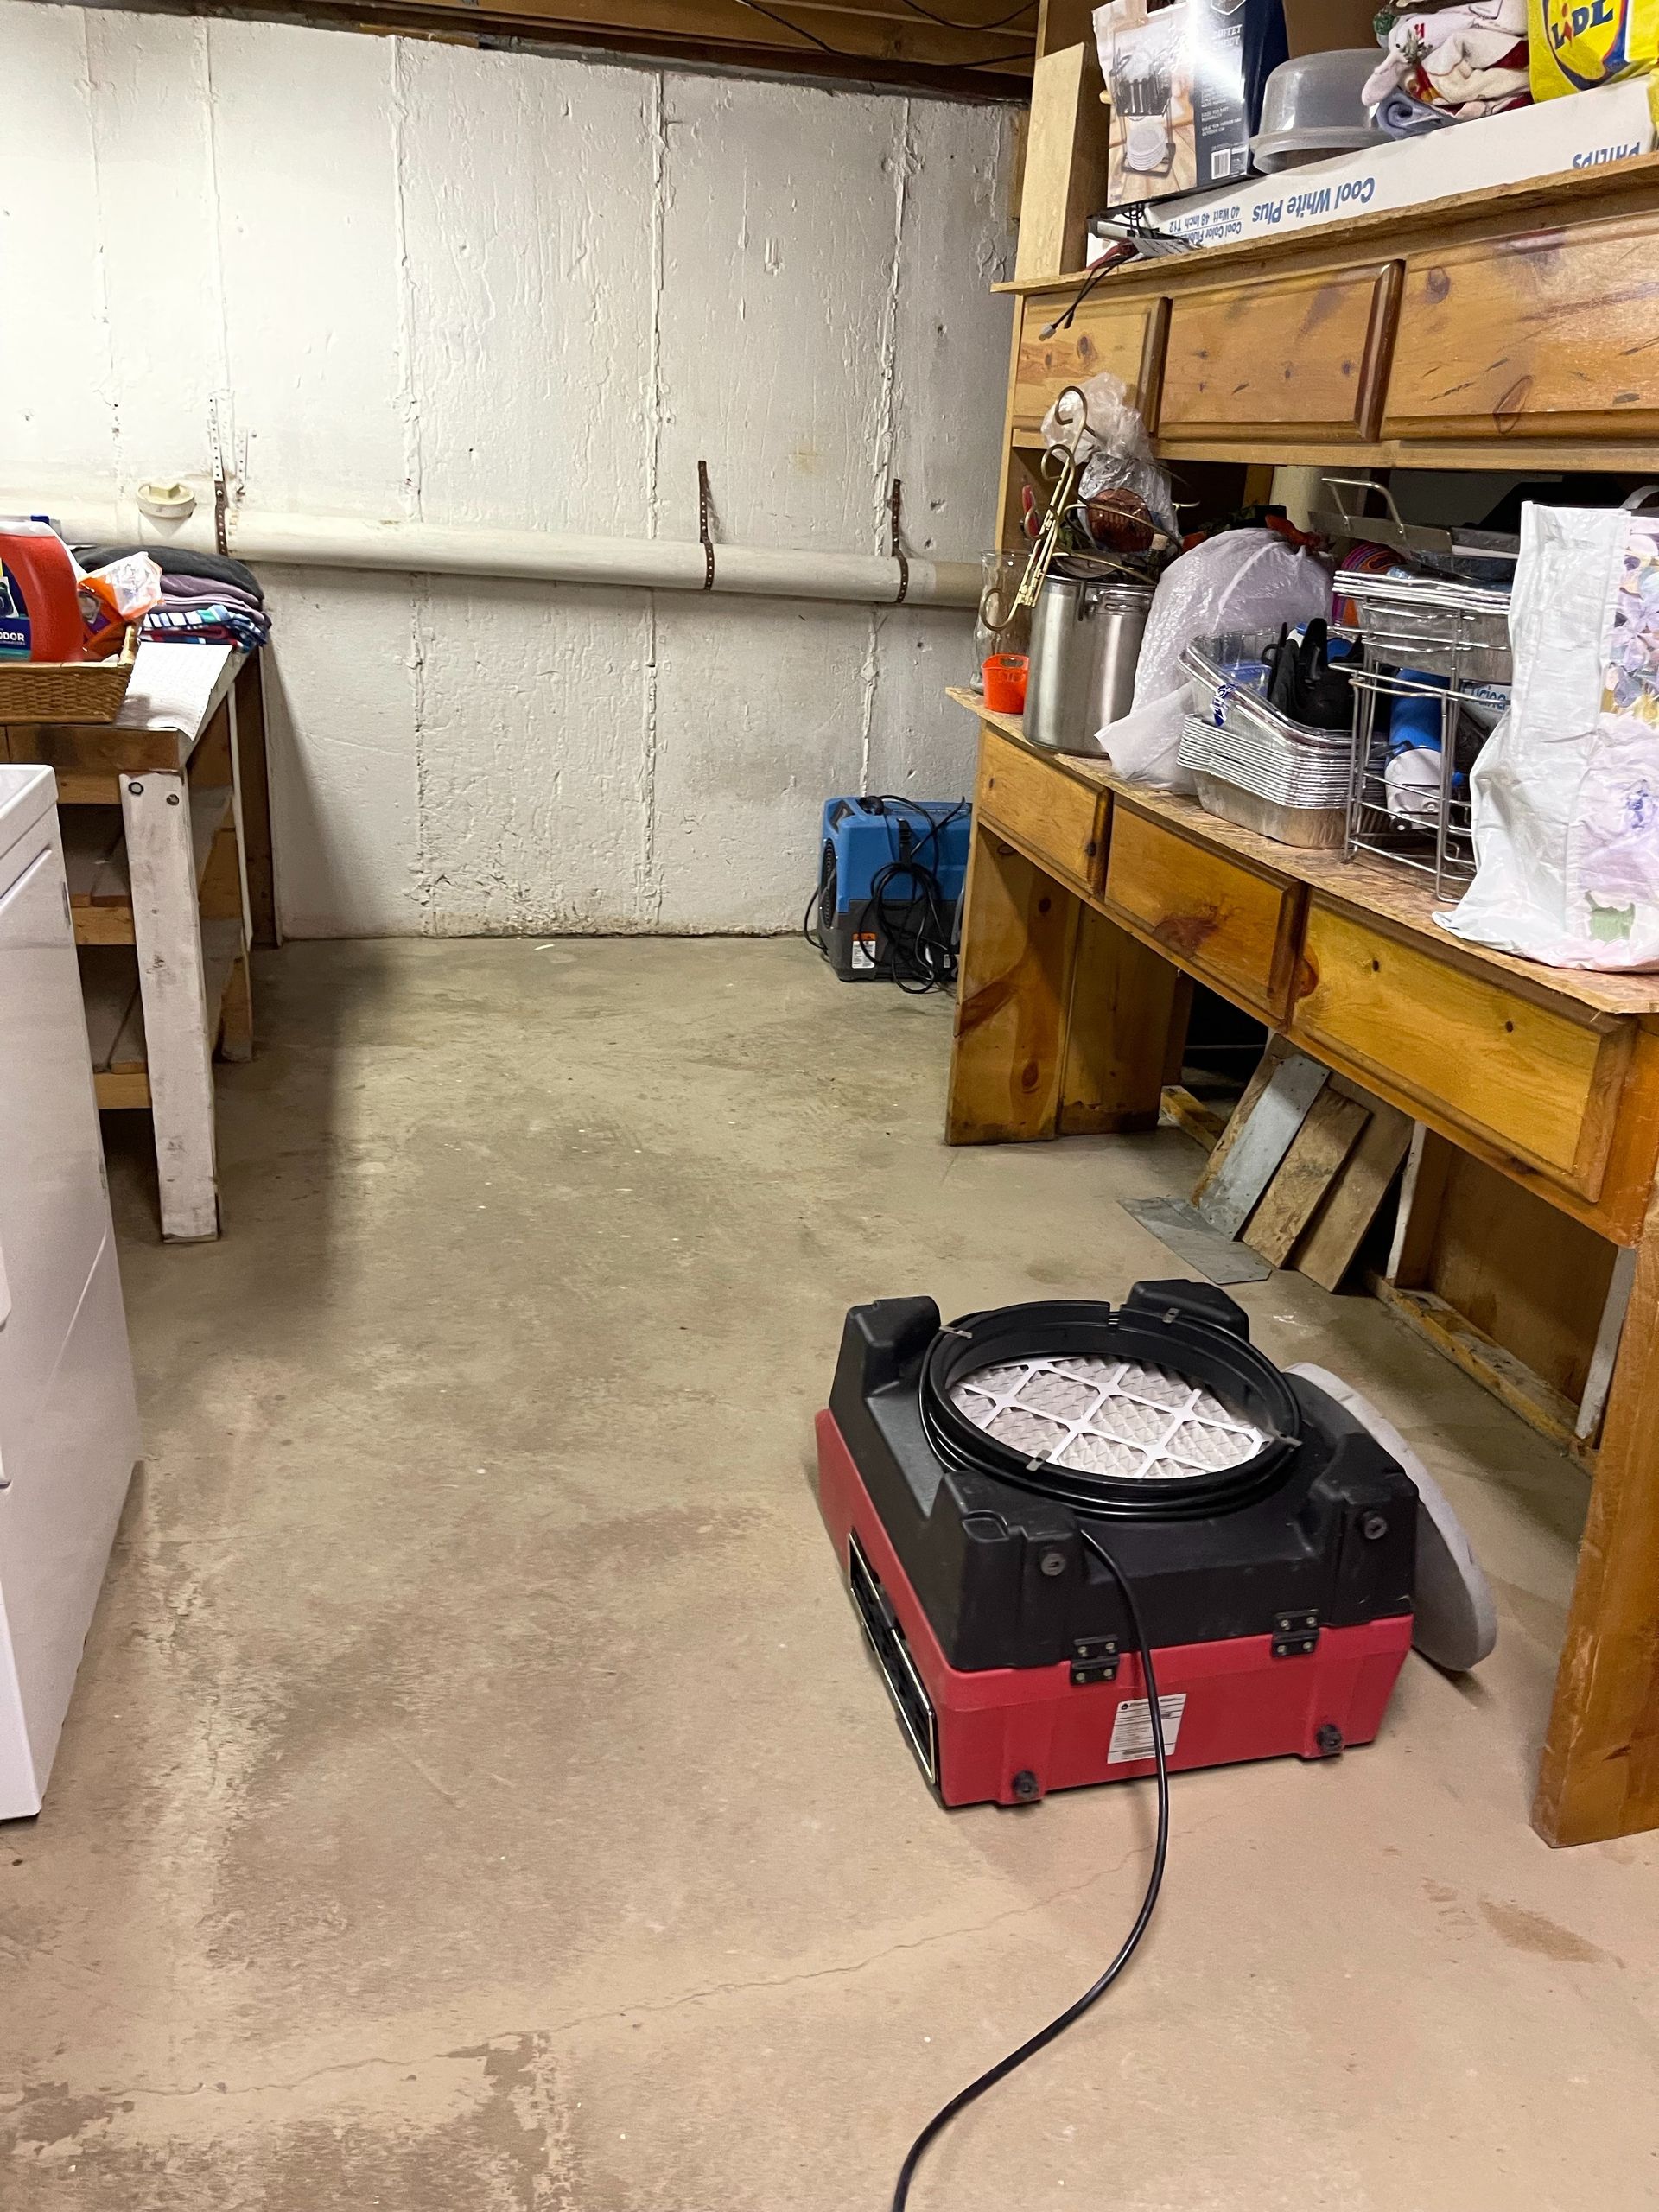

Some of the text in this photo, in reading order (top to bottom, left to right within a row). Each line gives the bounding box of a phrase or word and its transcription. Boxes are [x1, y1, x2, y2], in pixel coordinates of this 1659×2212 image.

[1211, 23, 1243, 39] UFFET
[1252, 177, 1375, 225] Cool White Plus
[1213, 208, 1230, 223] Watt
[1230, 206, 1241, 219] 40
[1169, 219, 1182, 233] T12
[1185, 215, 1199, 230] Inch
[1224, 221, 1242, 238] Cool
[1205, 226, 1224, 240] Color
